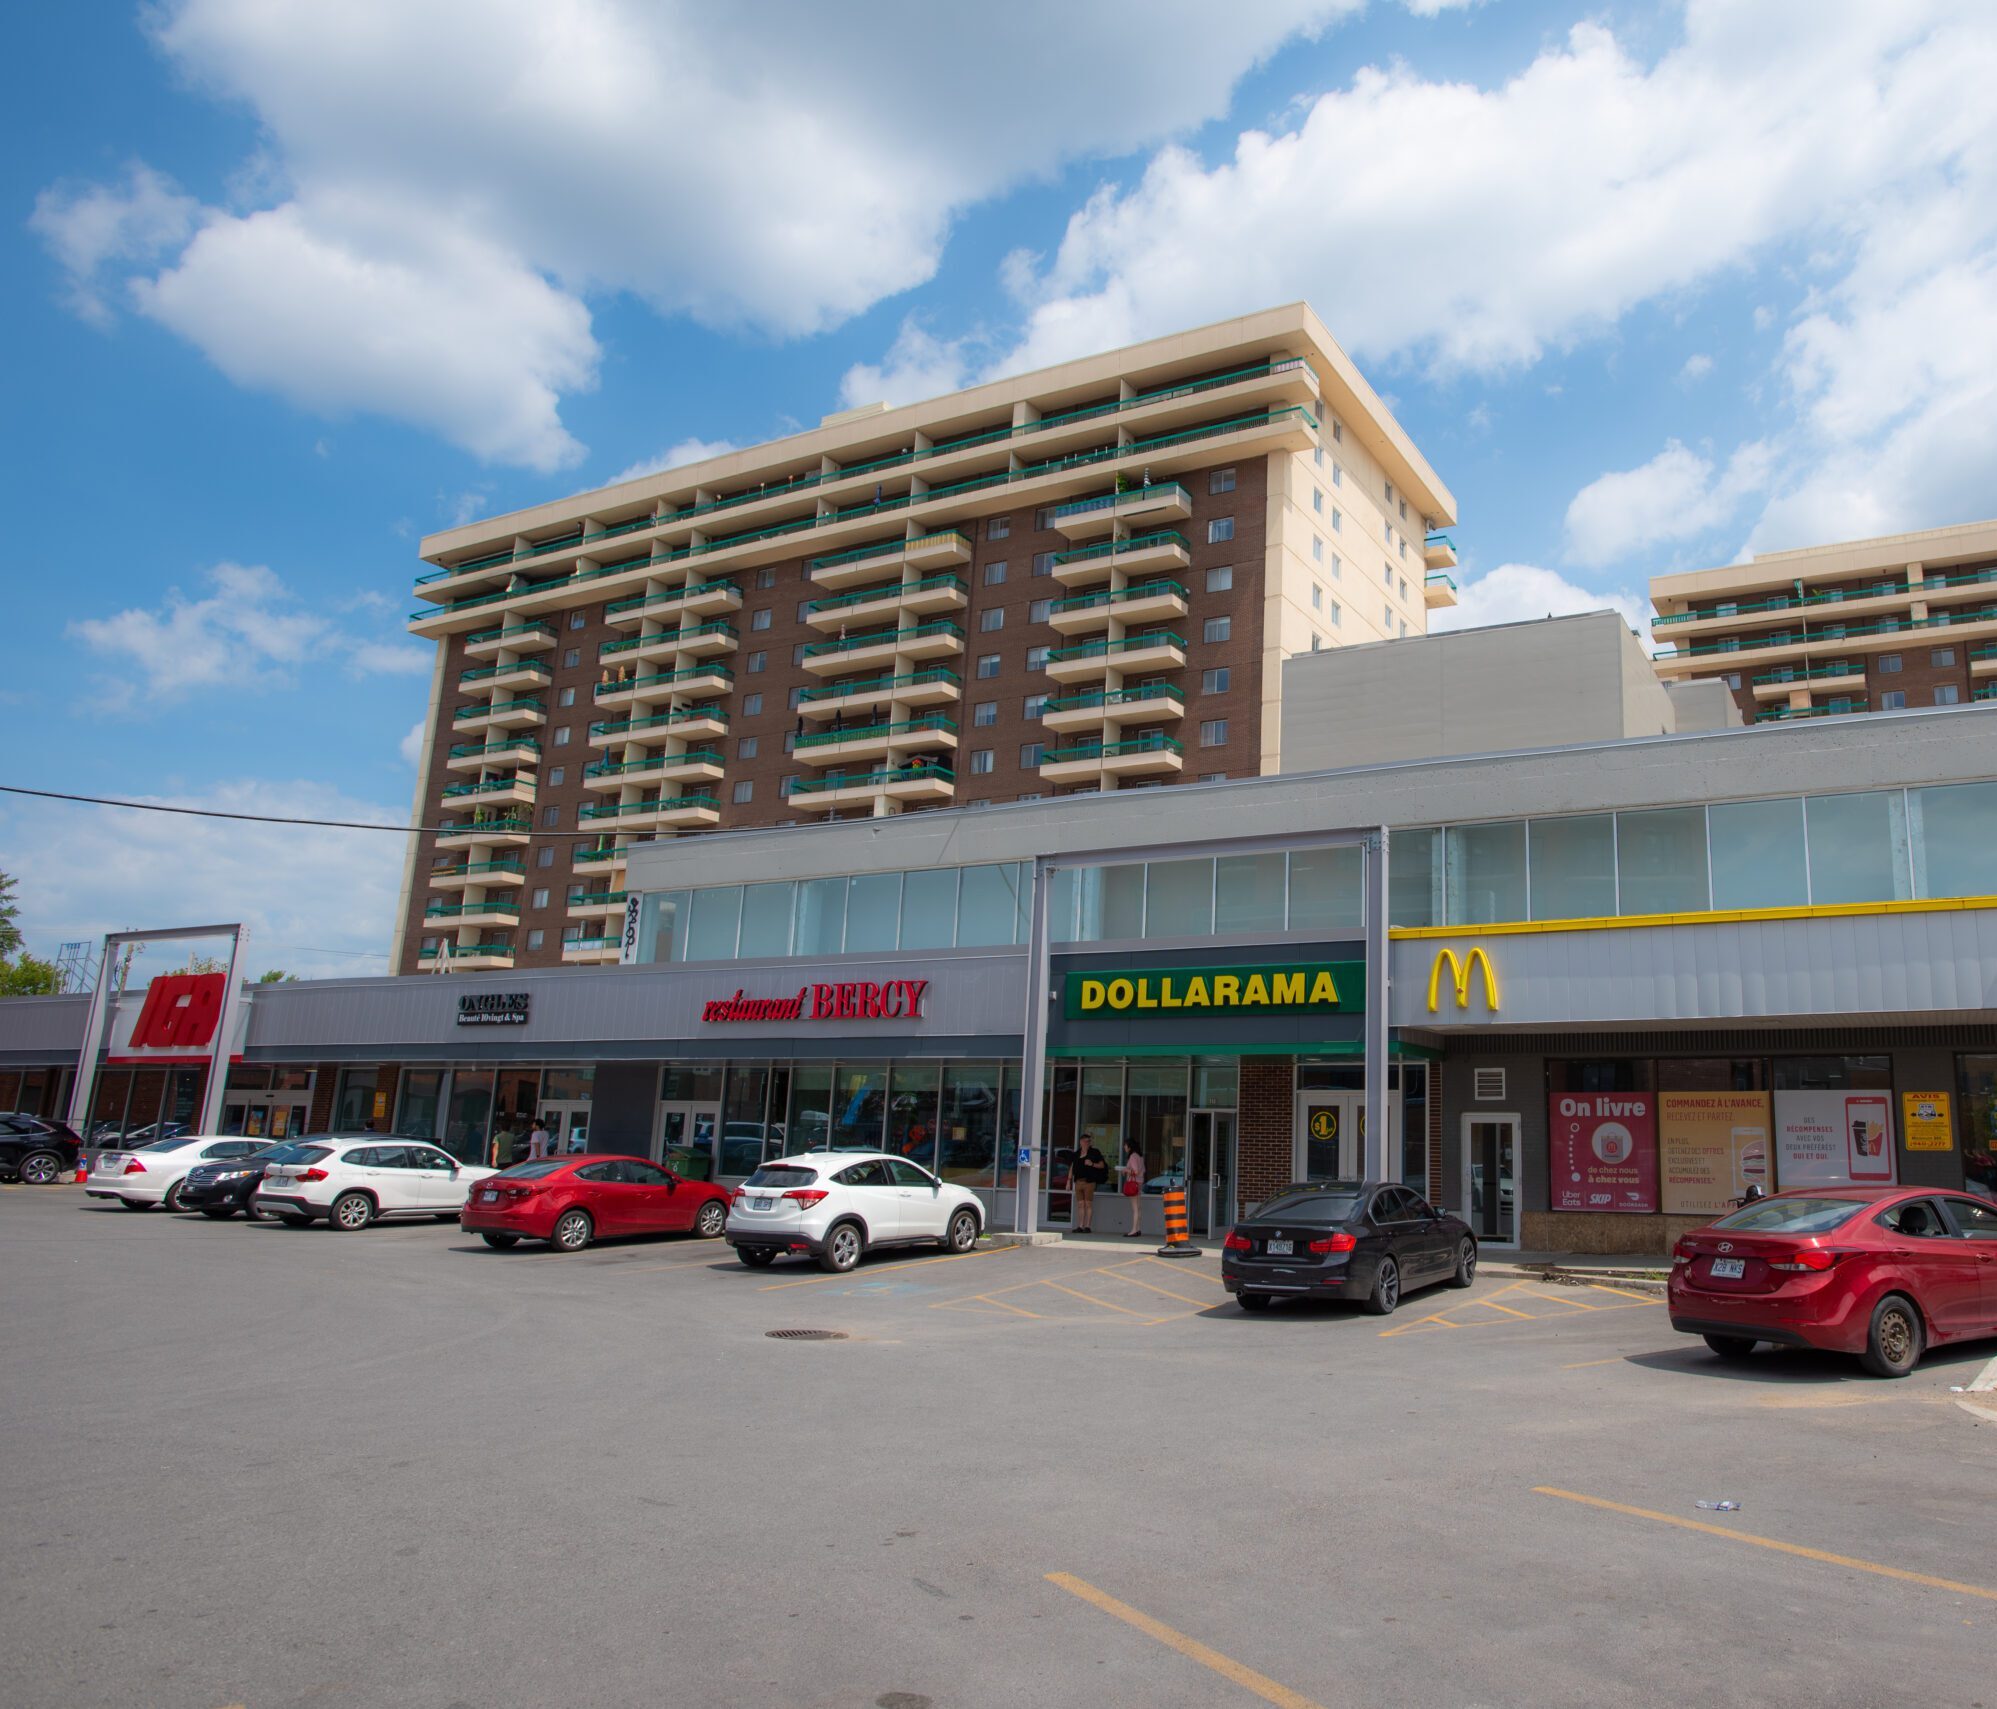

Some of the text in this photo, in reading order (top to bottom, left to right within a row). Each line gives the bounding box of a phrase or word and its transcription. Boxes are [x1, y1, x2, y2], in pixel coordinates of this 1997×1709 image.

[1081, 971, 1341, 1010] DOLLARAMA
[458, 993, 530, 1011] ONGLES
[701, 979, 929, 1022] restaurant BERCY
[128, 972, 228, 1048] IGA
[459, 1013, 480, 1022] Beauté
[504, 1013, 511, 1022] &
[512, 1013, 524, 1023] Spa
[1560, 1096, 1646, 1117] On livre
[1666, 1098, 1716, 1108] COMMANDEZ
[1717, 1097, 1724, 1108] À
[1666, 1112, 1695, 1121] RECEVEZ
[1697, 1112, 1706, 1121] ET
[1796, 1134, 1825, 1142] AVEC VOS
[1702, 1147, 1724, 1155] OFFRES
[1785, 1143, 1801, 1151] DEUX
[1587, 1166, 1598, 1174] de
[1599, 1166, 1618, 1174] chez
[1668, 1167, 1699, 1175] ACCUMULEZ
[1588, 1175, 1594, 1183] à
[1595, 1176, 1617, 1184] chez
[1562, 1191, 1580, 1199] Uber
[1589, 1193, 1611, 1204] SKIP
[1562, 1198, 1581, 1206] Eats
[1680, 1200, 1712, 1209] UTILISEZ
